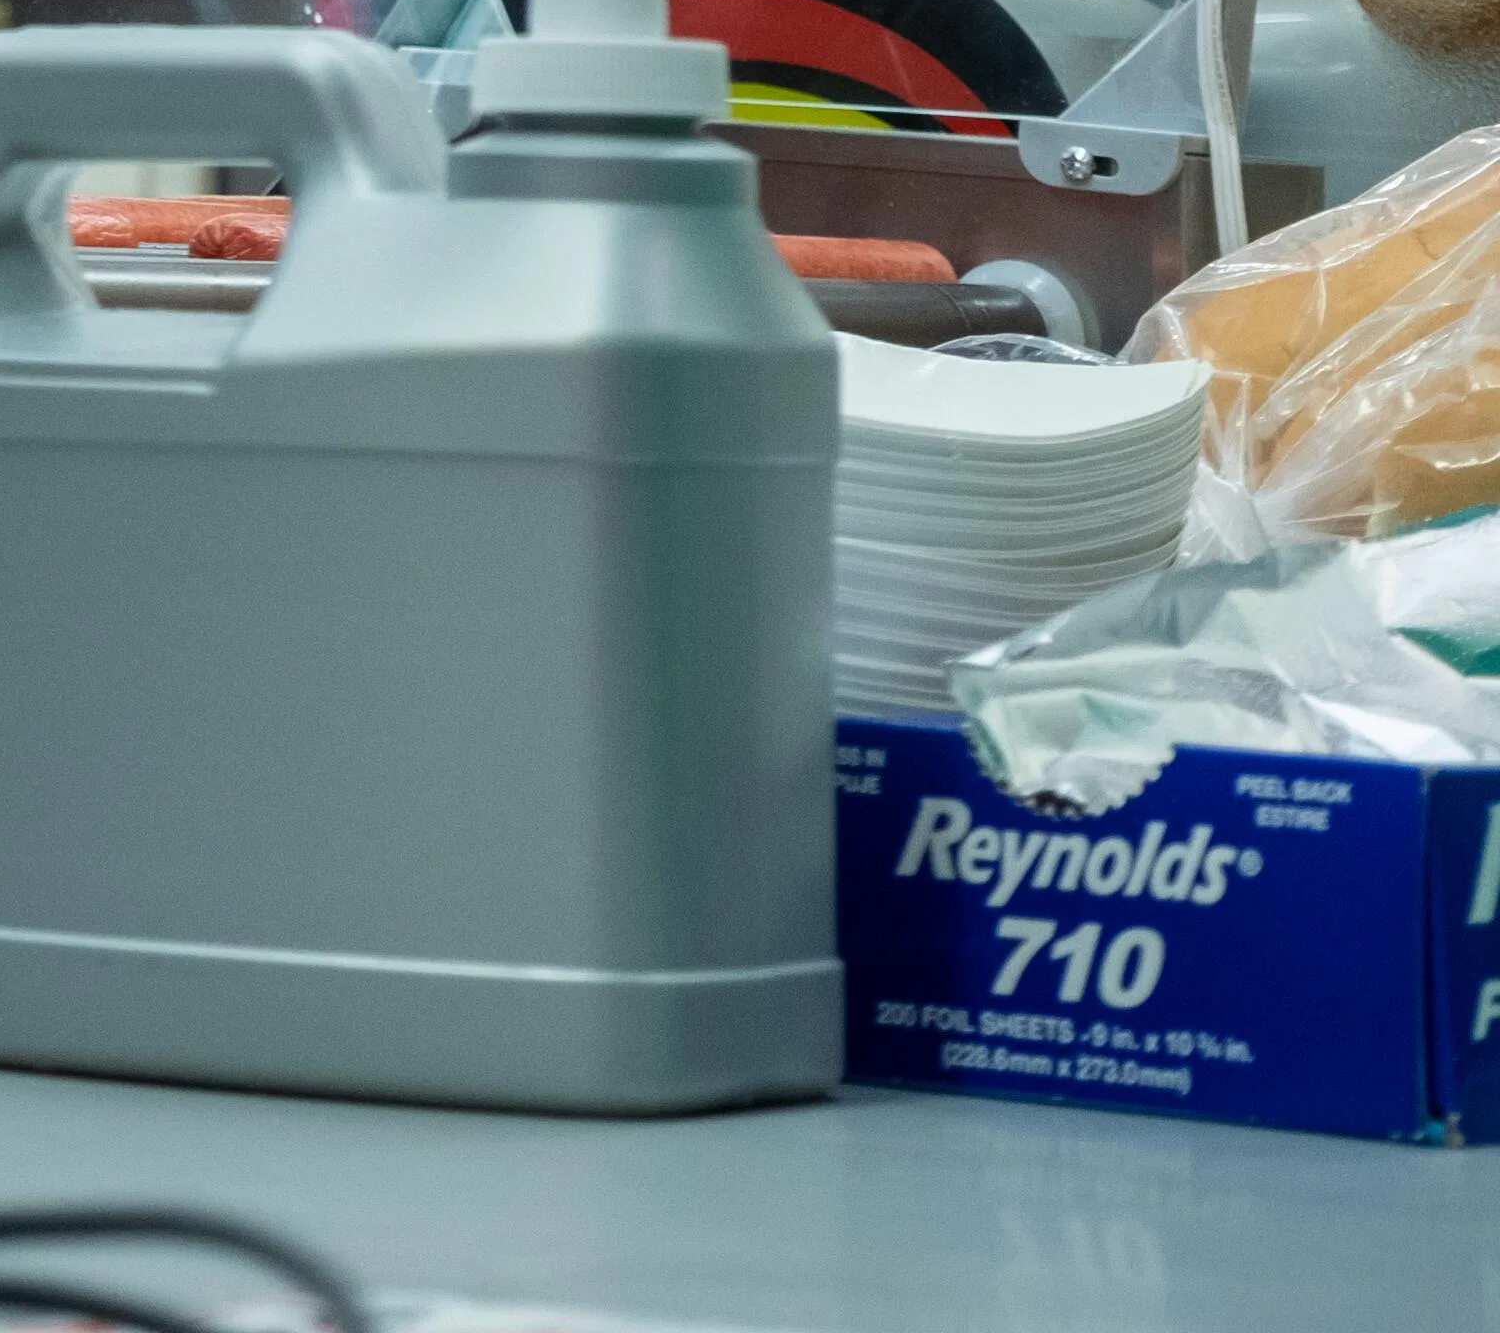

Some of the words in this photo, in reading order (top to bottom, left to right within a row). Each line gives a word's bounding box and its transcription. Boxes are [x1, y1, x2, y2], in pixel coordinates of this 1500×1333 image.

[1235, 774, 1288, 800] PEEL
[991, 915, 1167, 1010] 710
[920, 1005, 975, 1033] FOIL
[978, 1011, 1076, 1045] SHEETS
[1056, 1058, 1073, 1078] x
